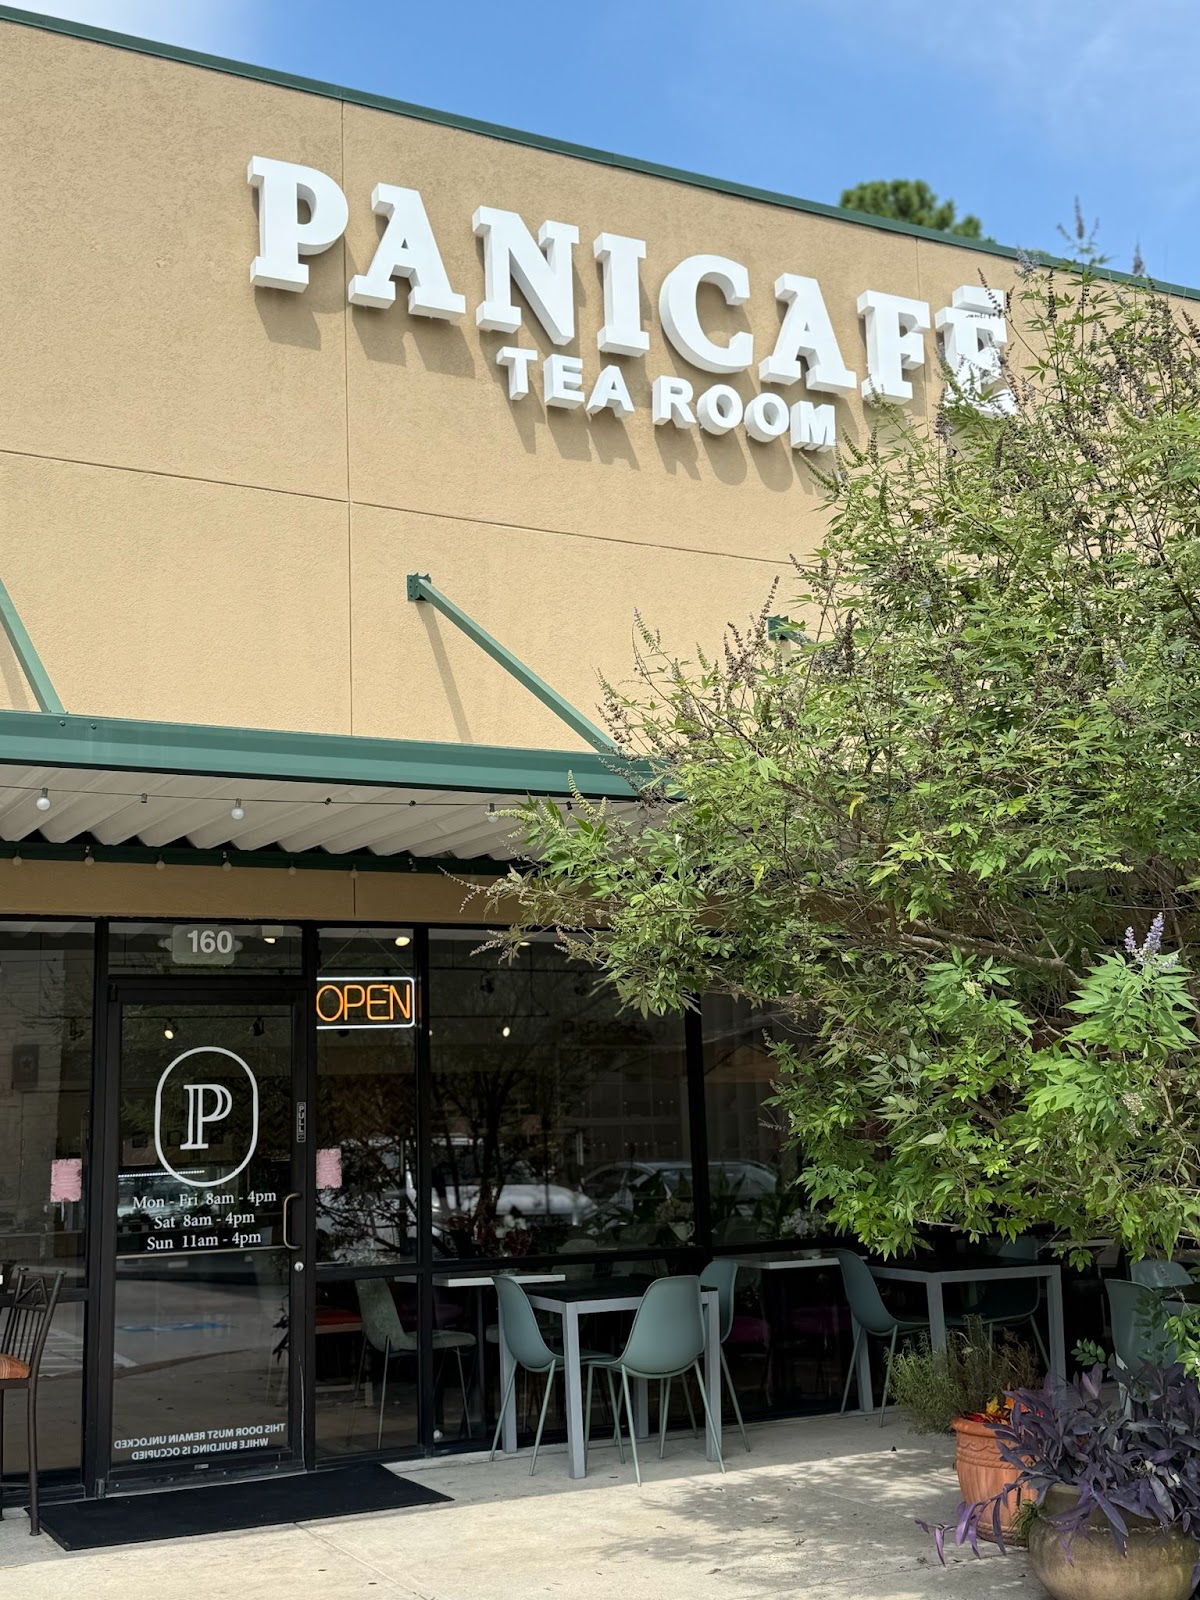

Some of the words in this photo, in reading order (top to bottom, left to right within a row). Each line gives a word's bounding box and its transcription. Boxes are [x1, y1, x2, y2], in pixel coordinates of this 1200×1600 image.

[496, 347, 634, 419] TEA
[652, 375, 836, 453] ROOM
[187, 930, 232, 953] 160
[316, 985, 410, 1021] OPEN
[180, 1083, 232, 1149] P
[133, 1196, 164, 1209] Mon
[179, 1194, 198, 1206] Fri
[206, 1193, 234, 1205] 8am
[247, 1190, 277, 1206] 4pm
[154, 1216, 175, 1229] Sat
[183, 1215, 212, 1227] 8am
[225, 1212, 255, 1228] 4pm
[147, 1237, 173, 1250] Sun
[182, 1235, 218, 1247] 11am
[232, 1232, 261, 1248] 4pm
